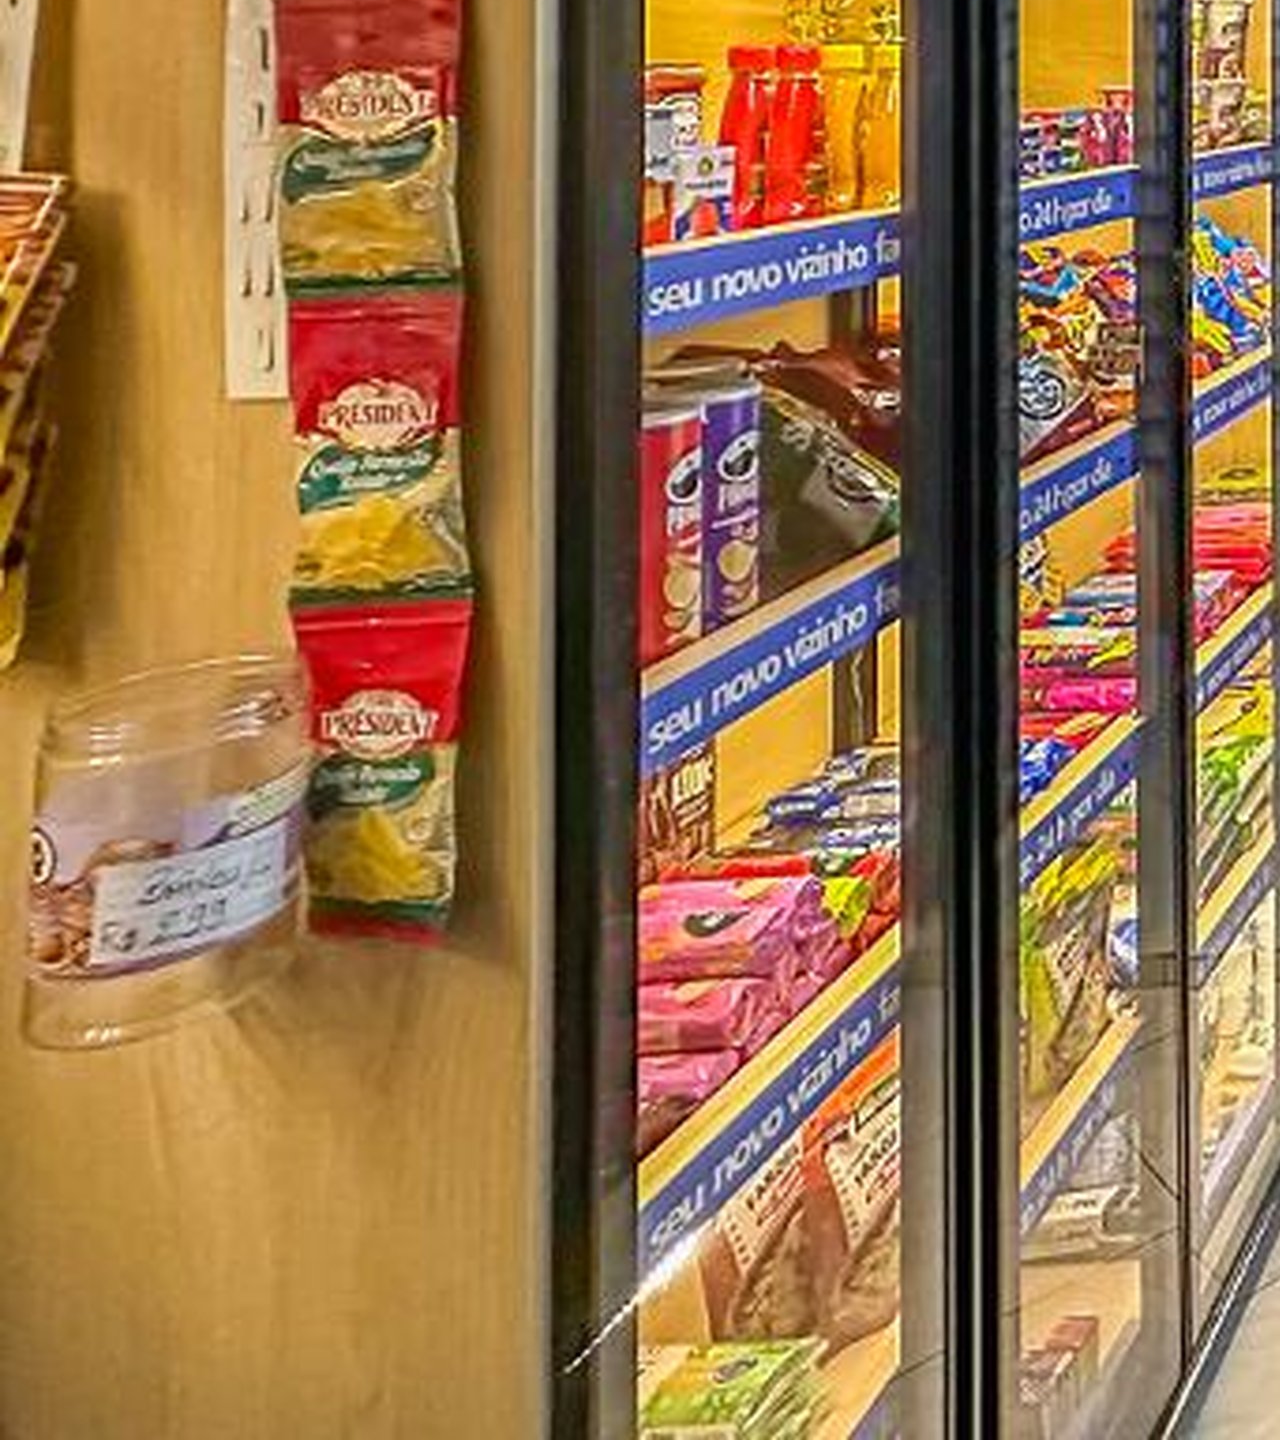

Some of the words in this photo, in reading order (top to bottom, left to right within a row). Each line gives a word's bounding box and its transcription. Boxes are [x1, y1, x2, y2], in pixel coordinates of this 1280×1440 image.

[649, 278, 701, 316] seu
[712, 262, 781, 301] novo
[786, 240, 868, 283] vizinho
[649, 700, 702, 754] seu
[711, 655, 781, 716] novo
[785, 602, 868, 669] vizinho
[650, 1184, 703, 1252] seu
[713, 1106, 784, 1193] novo
[787, 1018, 872, 1112] vizinho
